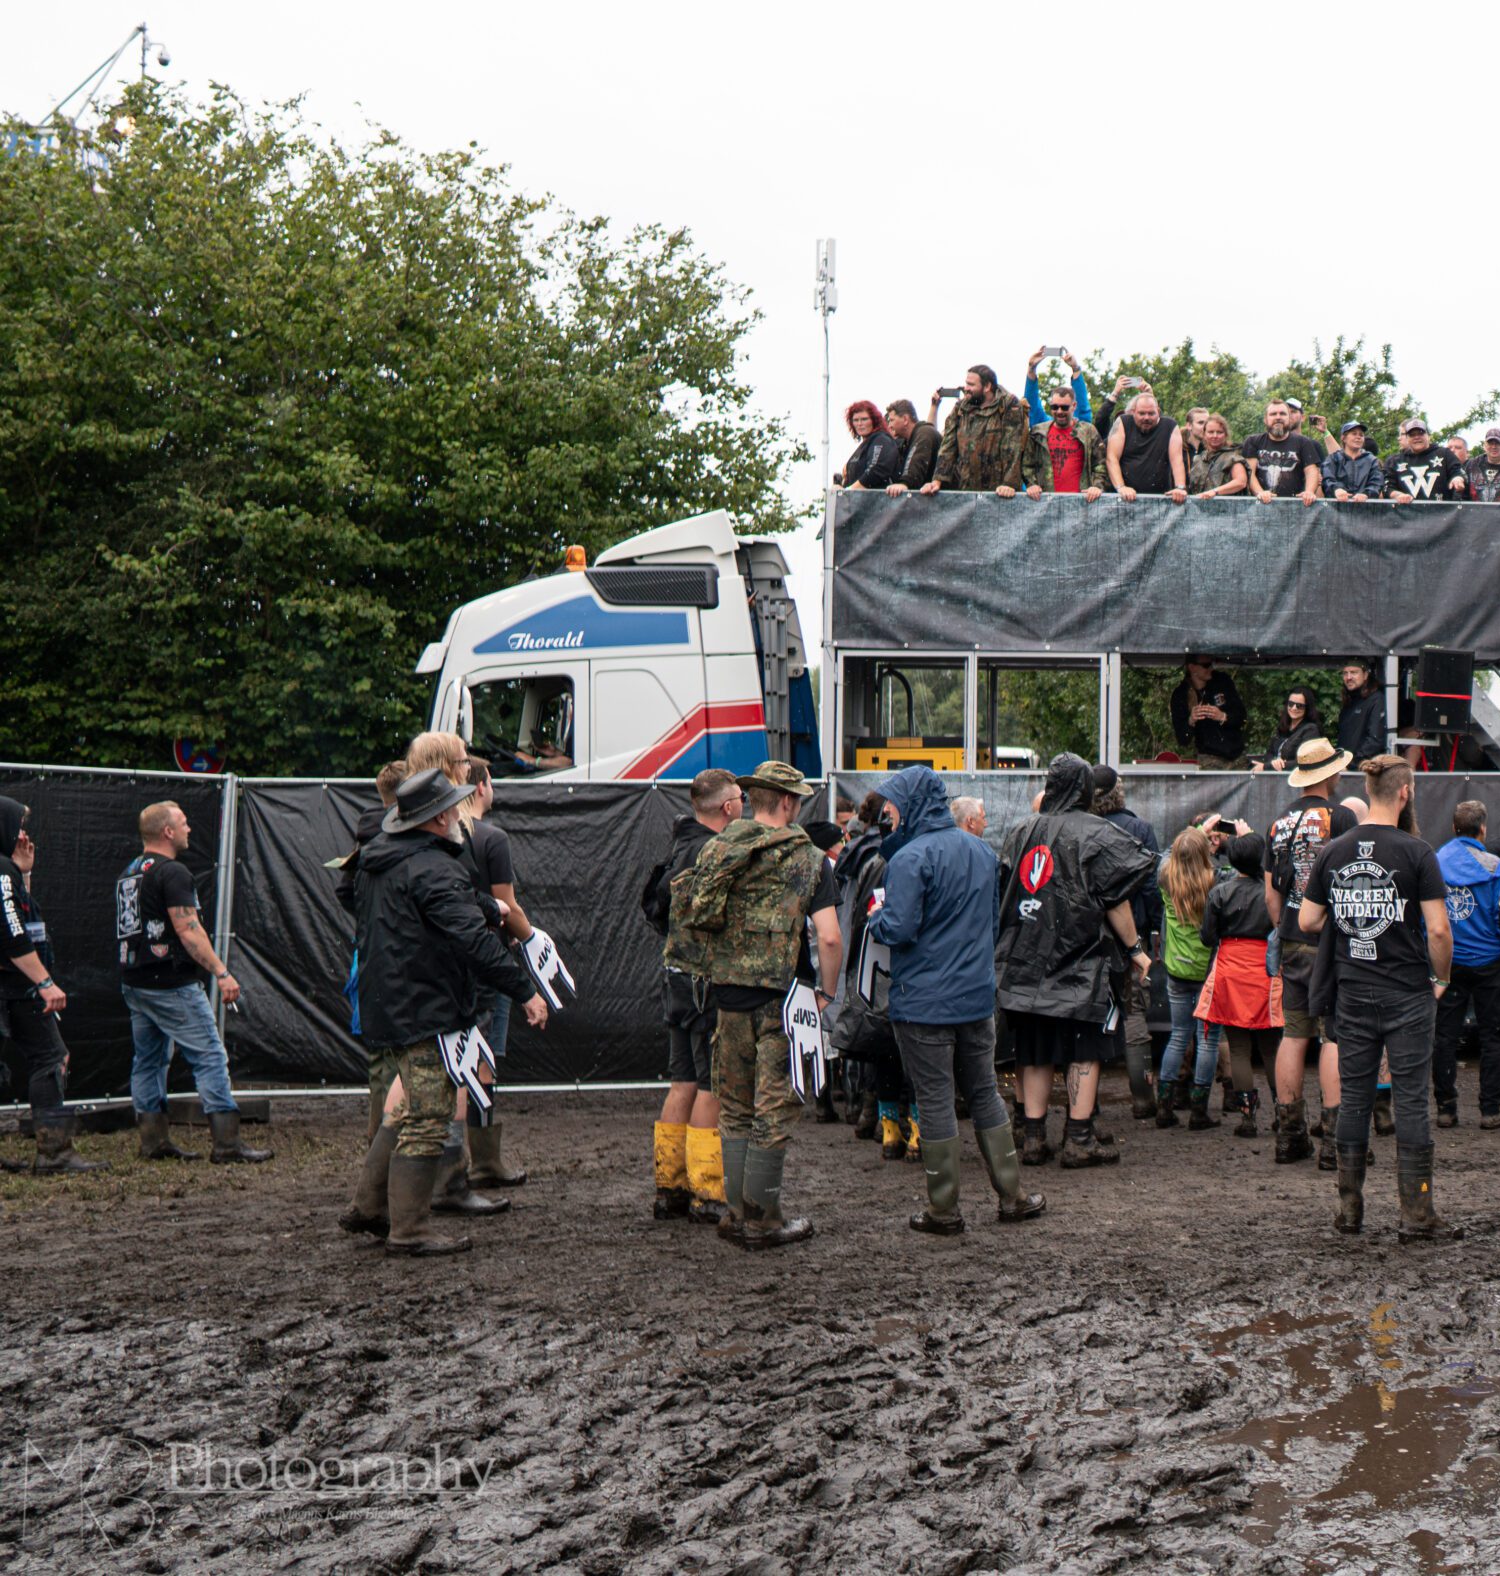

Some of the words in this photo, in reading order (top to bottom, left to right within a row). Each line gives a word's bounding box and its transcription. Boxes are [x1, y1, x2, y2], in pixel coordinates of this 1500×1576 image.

[508, 631, 584, 650] Thorald
[1342, 864, 1365, 877] W:O:A
[0, 874, 13, 900] SEA
[1331, 888, 1396, 903] WACKEN
[1328, 898, 1408, 922] OUNDATION
[793, 1007, 818, 1029] EMP
